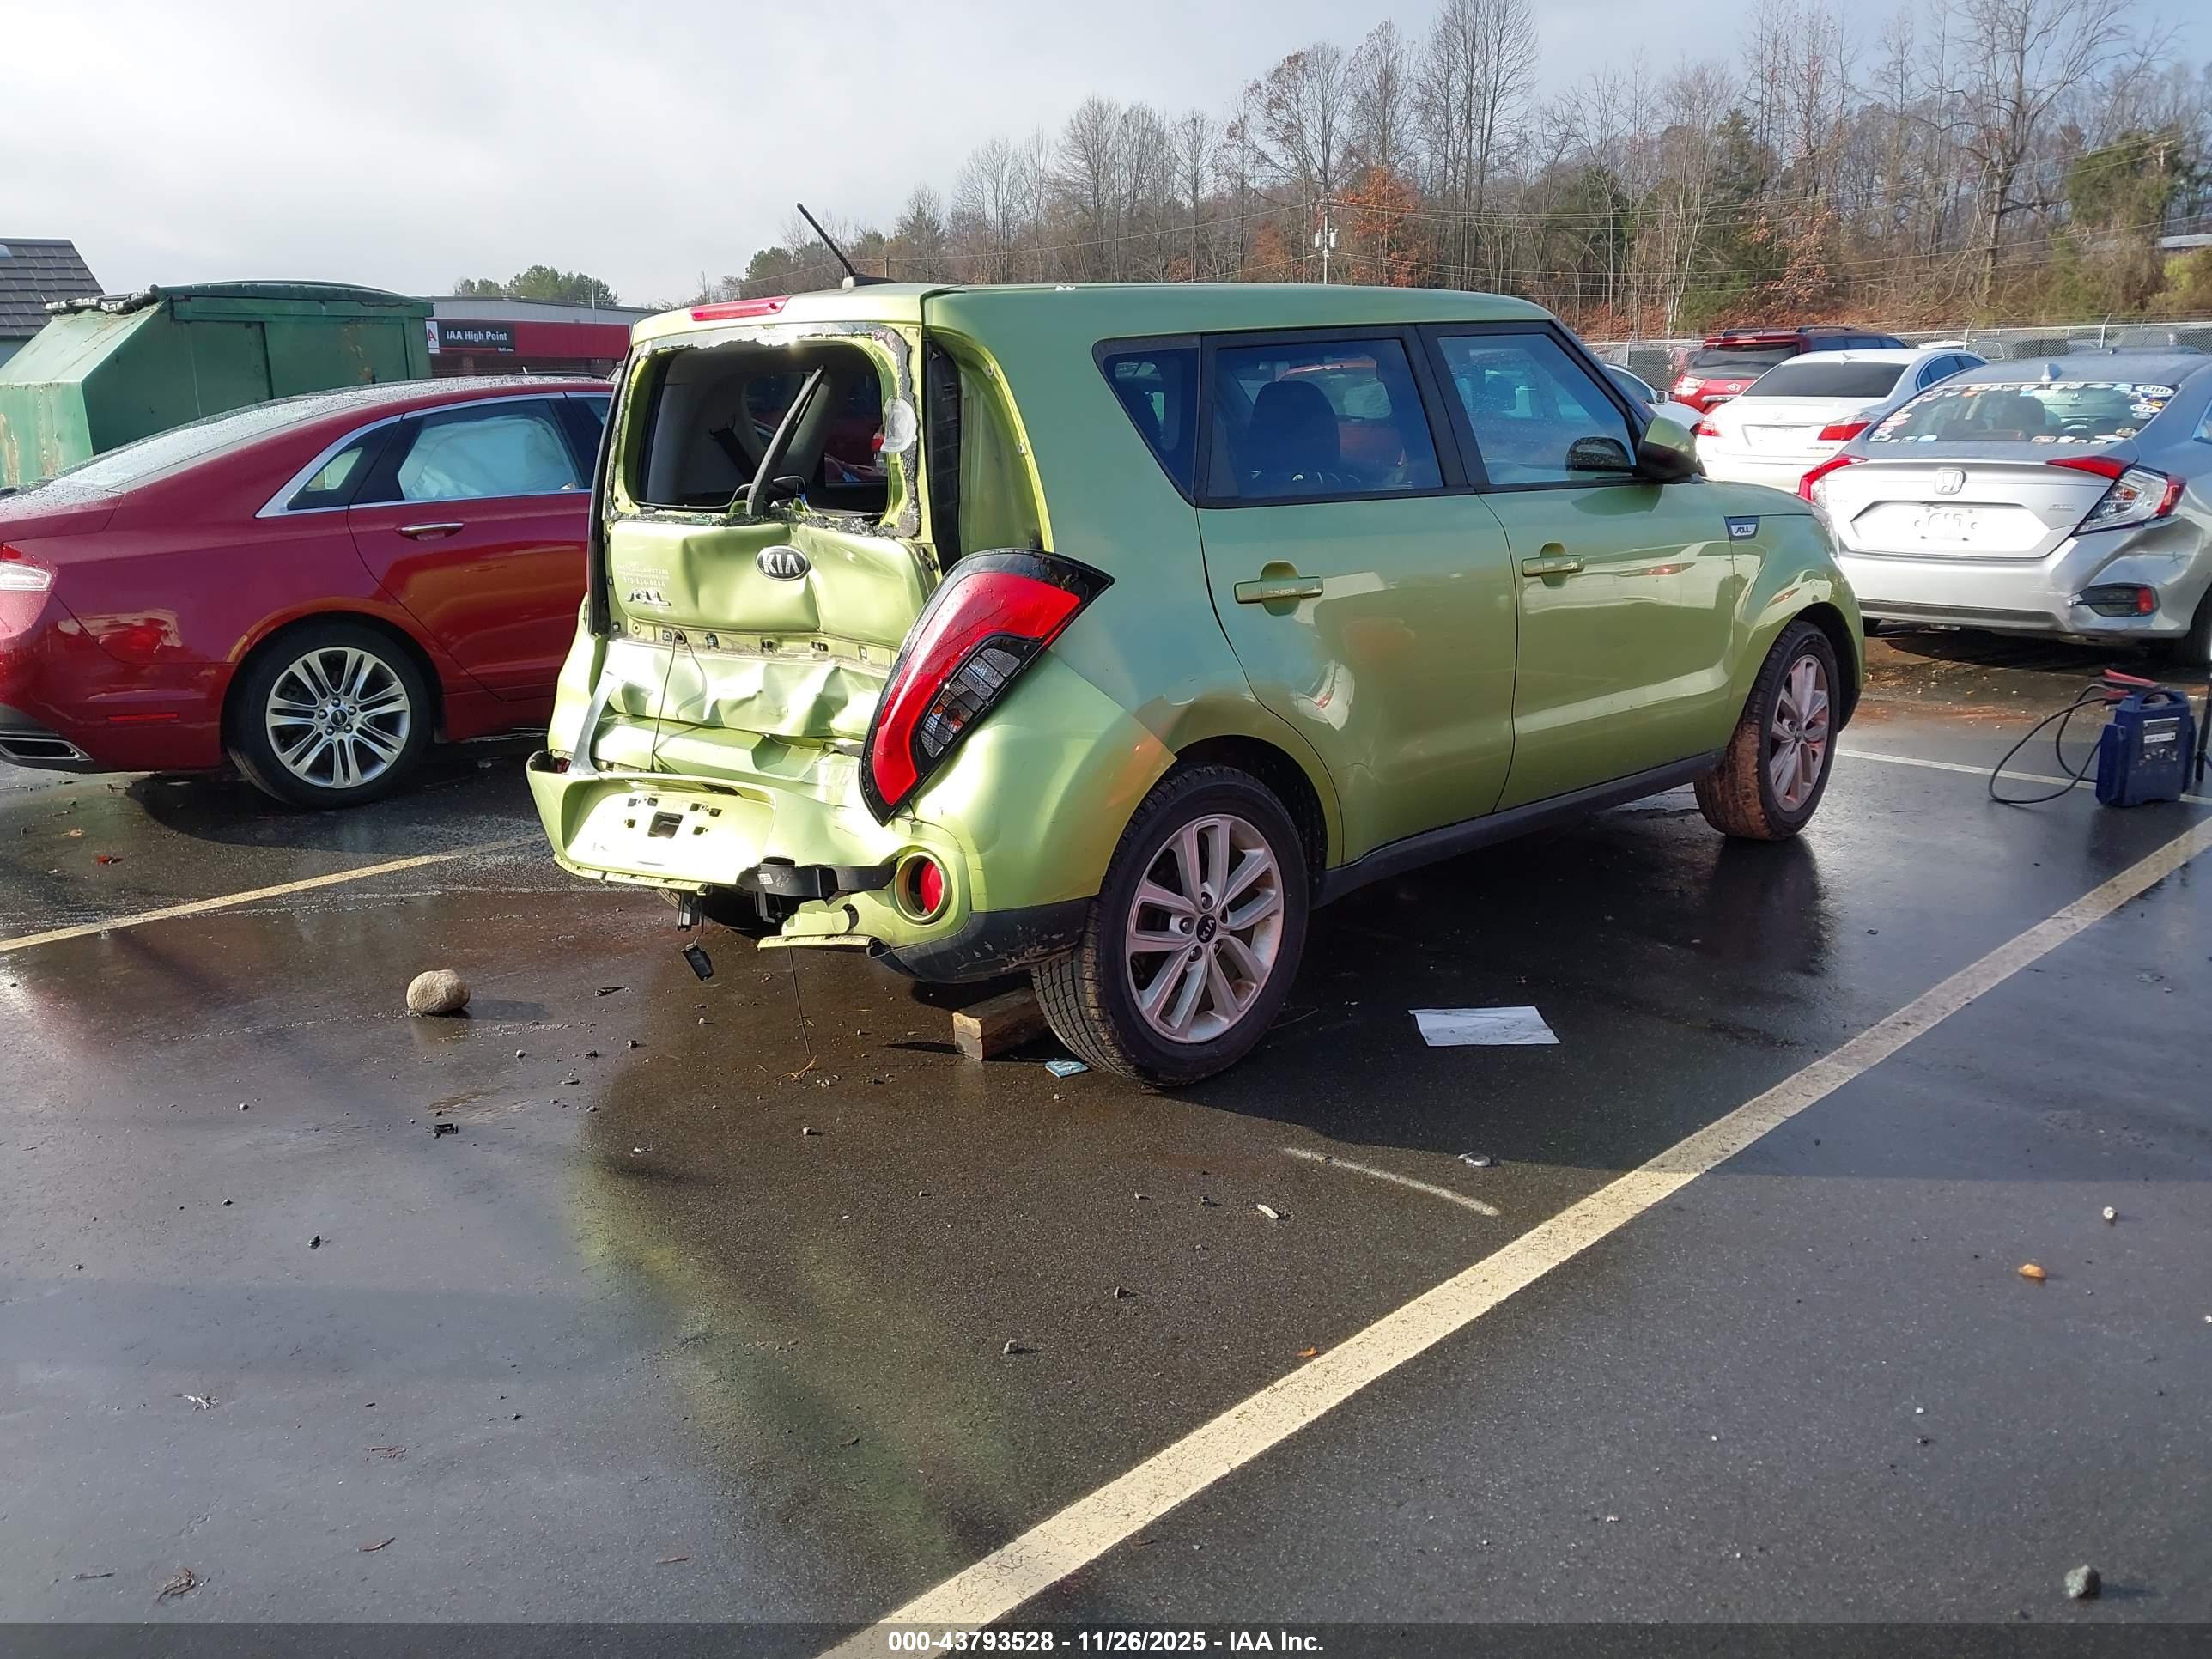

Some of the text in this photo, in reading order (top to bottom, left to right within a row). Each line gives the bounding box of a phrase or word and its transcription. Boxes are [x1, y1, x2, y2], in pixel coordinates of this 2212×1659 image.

[446, 330, 508, 343] IAA High Point
[763, 552, 801, 574] KIA
[1200, 919, 1215, 940] KIA
